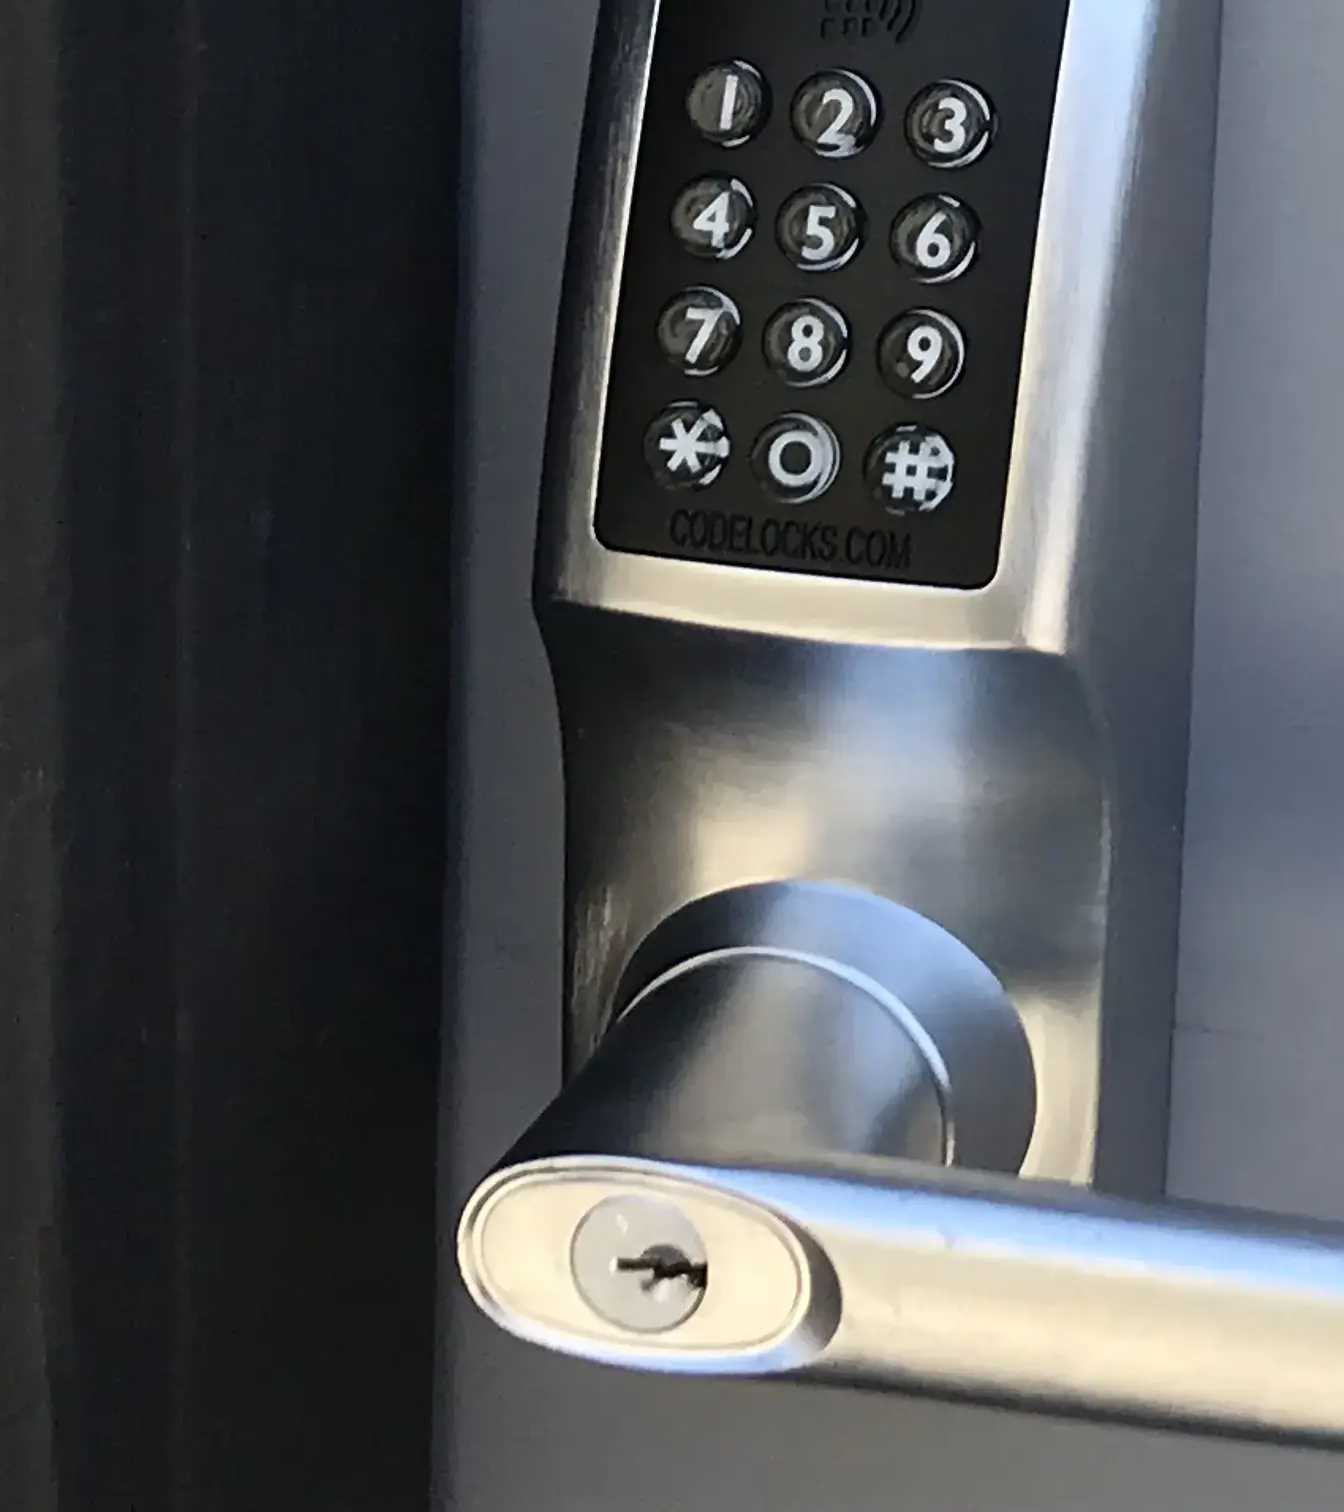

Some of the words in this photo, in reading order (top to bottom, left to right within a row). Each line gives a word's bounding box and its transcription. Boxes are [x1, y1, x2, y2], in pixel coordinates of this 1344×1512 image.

[818, 89, 856, 147] 2
[933, 97, 967, 153] 3
[692, 191, 730, 248] 4
[800, 205, 837, 261] 5
[915, 212, 951, 268] 6
[684, 308, 722, 364] 7
[786, 315, 826, 372] 8
[905, 326, 943, 383] 9
[668, 508, 913, 569] CODELOCKS.COM
